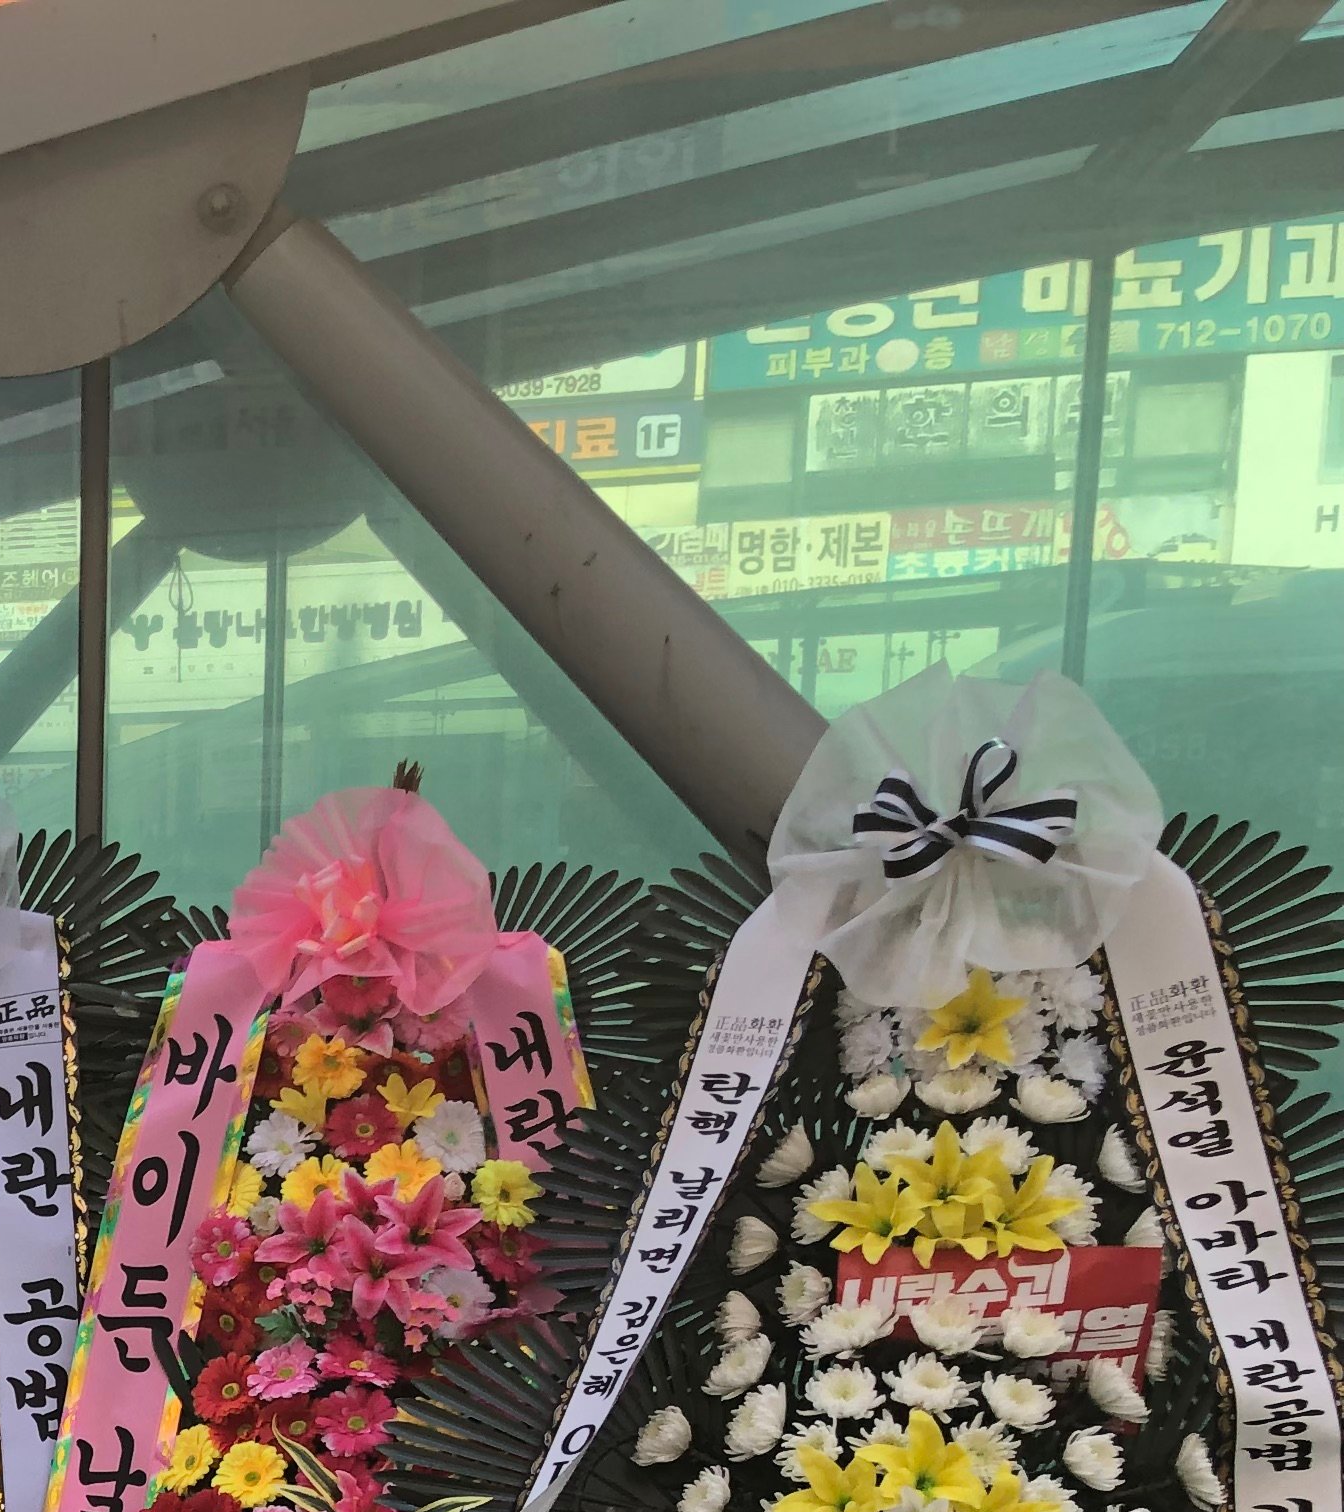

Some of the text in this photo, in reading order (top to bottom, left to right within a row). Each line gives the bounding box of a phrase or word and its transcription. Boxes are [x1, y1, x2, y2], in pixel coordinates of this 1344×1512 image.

[765, 342, 870, 381] 피부과
[1156, 312, 1332, 352] 712-1070
[640, 421, 679, 451] 1F
[941, 507, 1054, 546] 손뜨개
[486, 1010, 582, 1156] 내란
[684, 1072, 760, 1144] 탄핵
[1144, 1039, 1236, 1158] 윤석열
[98, 1013, 238, 1373] 바이든
[637, 1167, 723, 1275] 날리면
[1185, 1180, 1290, 1295] 아바타
[4, 1276, 81, 1444] 공범
[582, 1301, 659, 1400] 김은혜
[1225, 1318, 1326, 1472] 내란공범
